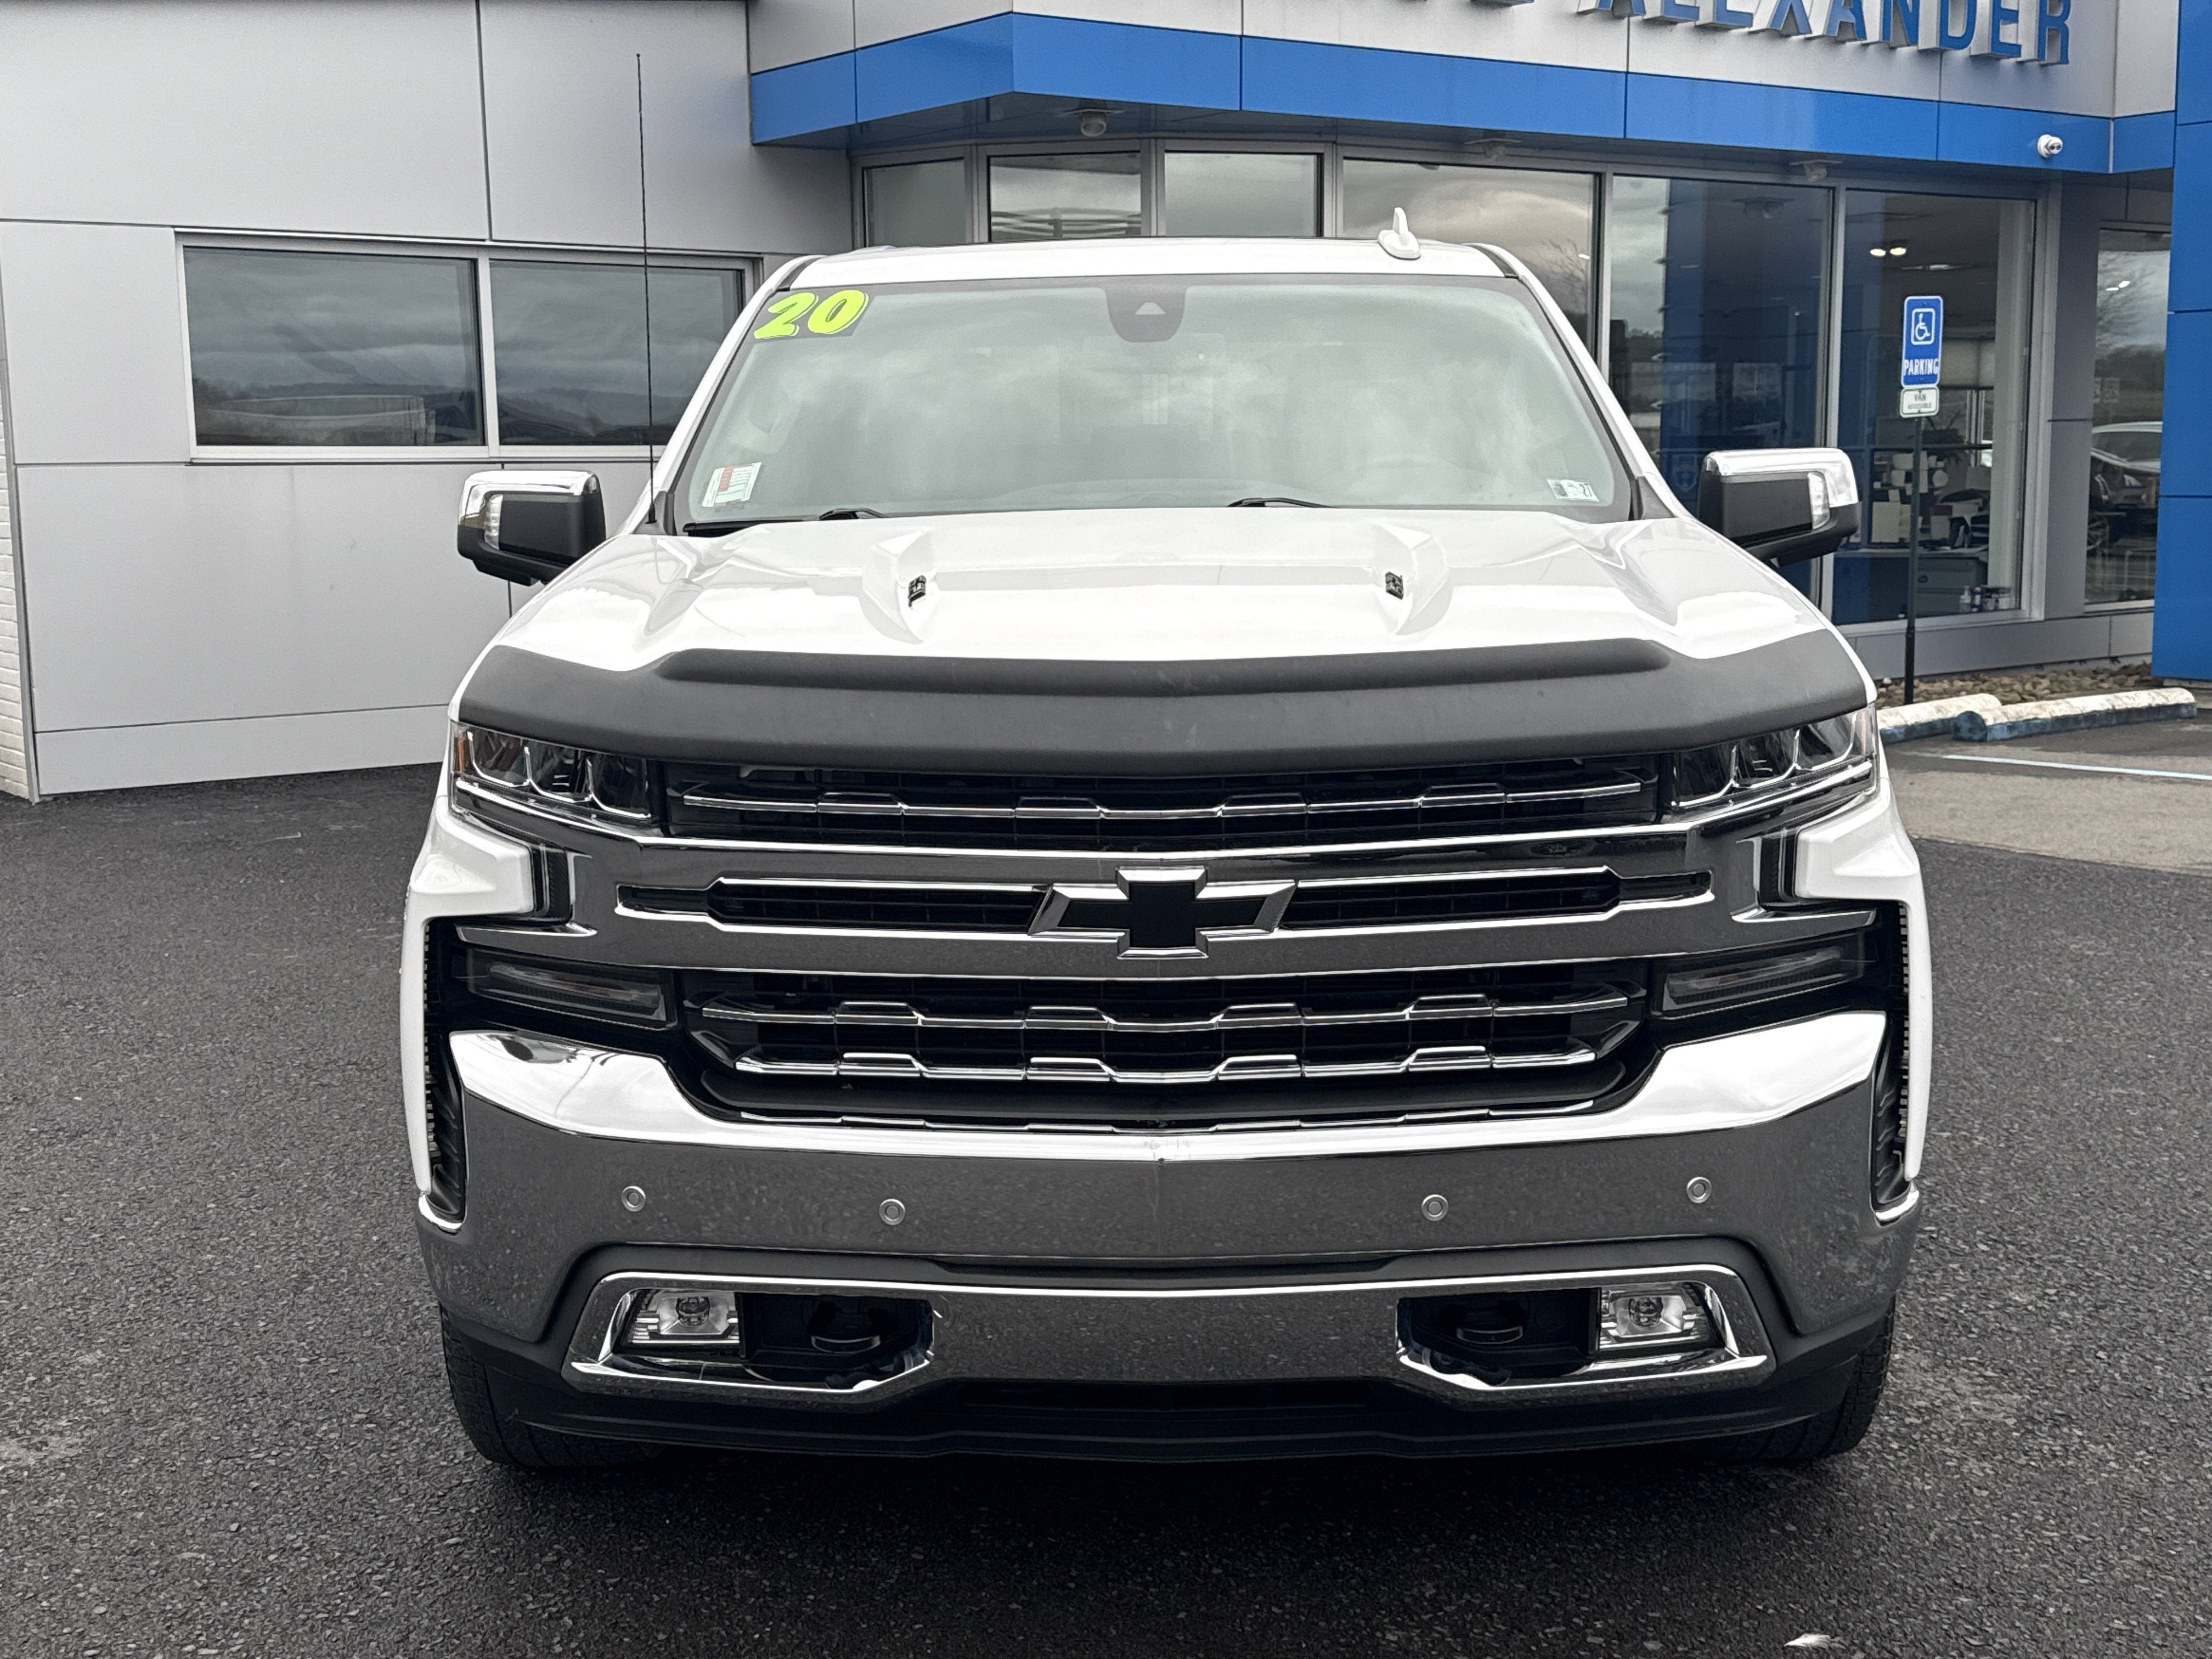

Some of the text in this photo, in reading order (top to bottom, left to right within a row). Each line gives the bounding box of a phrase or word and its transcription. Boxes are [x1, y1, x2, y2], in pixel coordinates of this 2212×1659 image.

[1595, 0, 2071, 64] ANDER
[754, 290, 869, 339] 20
[1904, 358, 1939, 376] PARKING
